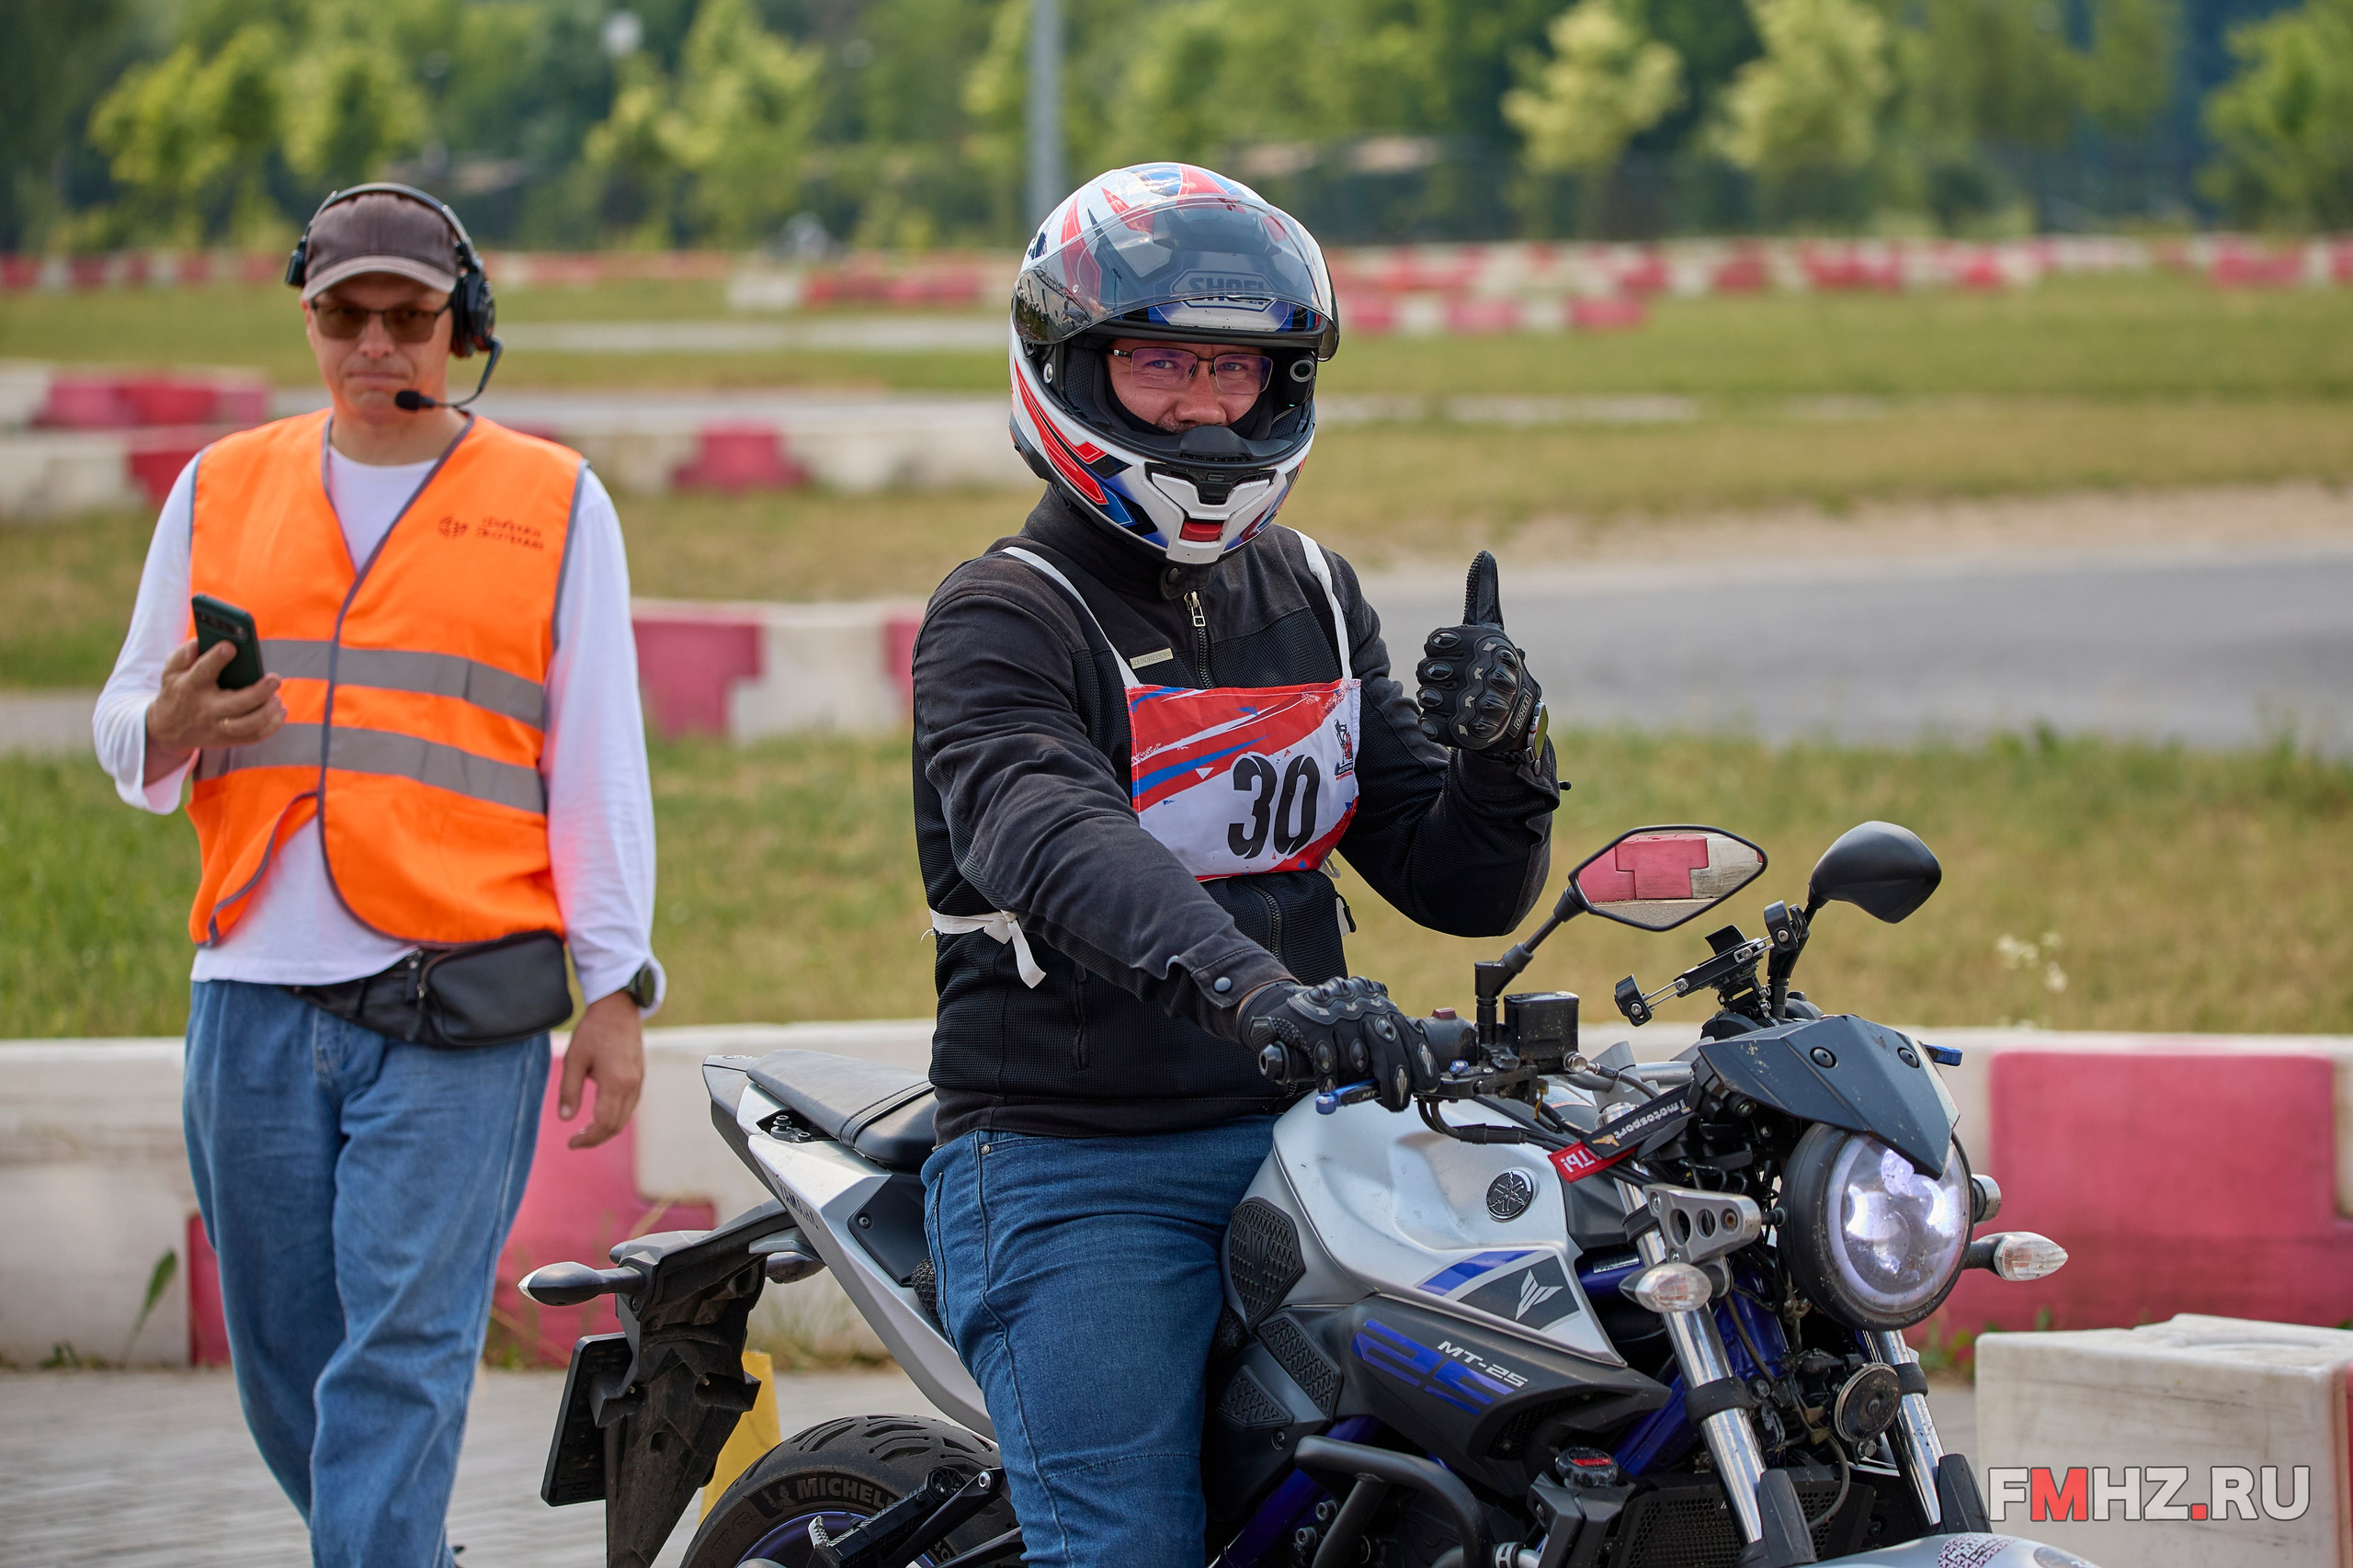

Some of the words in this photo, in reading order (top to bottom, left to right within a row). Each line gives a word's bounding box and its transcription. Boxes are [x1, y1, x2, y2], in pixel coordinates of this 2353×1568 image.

[1188, 277, 1265, 301] SHOEI
[1227, 754, 1321, 860] 30
[777, 1180, 819, 1230] YAMAHA
[1437, 1341, 1529, 1388] MT-25
